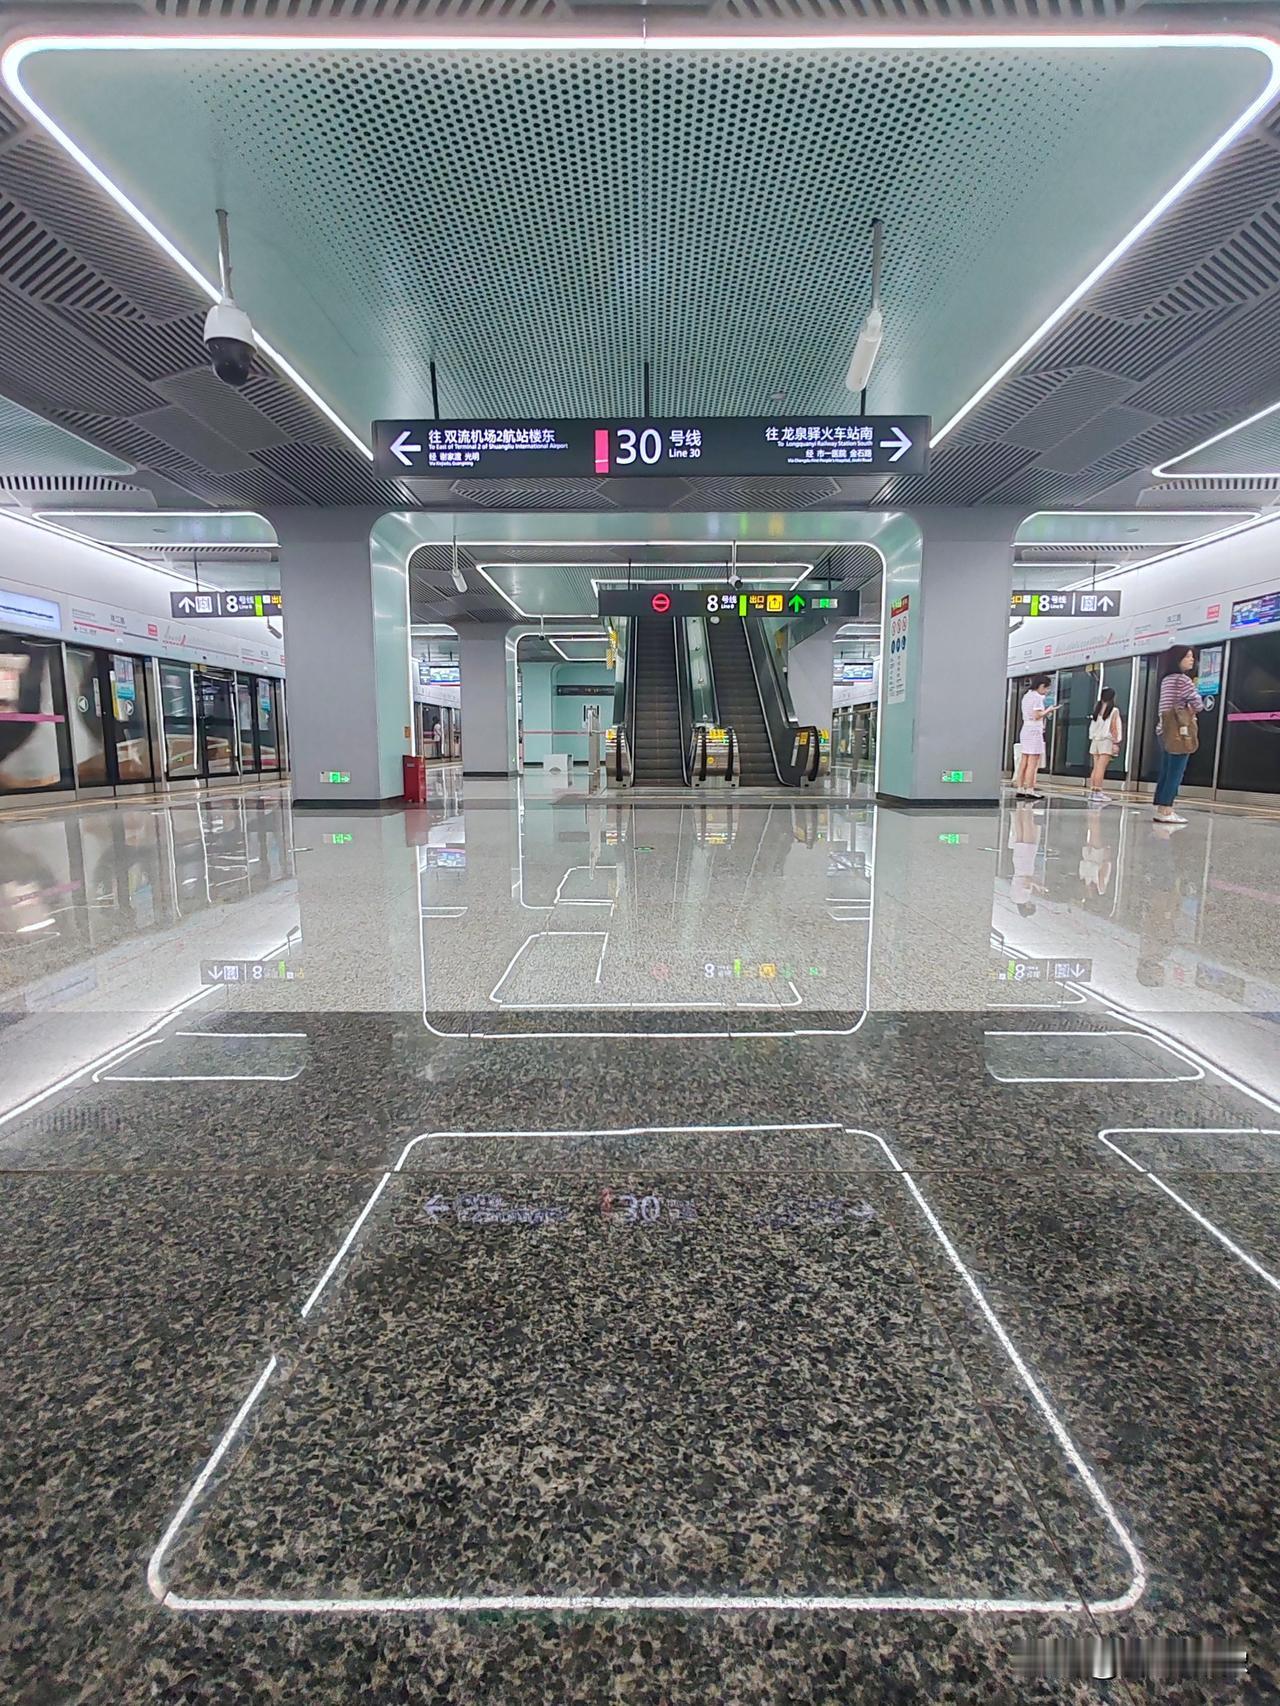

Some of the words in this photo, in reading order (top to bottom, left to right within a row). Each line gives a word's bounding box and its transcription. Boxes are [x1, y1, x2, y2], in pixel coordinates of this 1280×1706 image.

[428, 428, 442, 444] 往
[444, 428, 556, 444] 双流机场2航站楼东
[765, 426, 779, 441] 往
[780, 426, 873, 441] 龙泉驿火车站南
[488, 443, 515, 451] Shuangliu
[549, 442, 569, 450] Airport
[615, 428, 662, 465] 30
[669, 429, 702, 447] 号线
[668, 448, 688, 458] Line
[689, 448, 701, 458] 30
[805, 448, 814, 458] 经
[816, 449, 847, 458] 市一医院
[428, 451, 437, 461] 经
[464, 451, 480, 462] 光明
[226, 595, 239, 613] 8
[707, 594, 719, 612] 8
[721, 595, 737, 604] 号线
[749, 595, 765, 604] 出口
[1038, 595, 1050, 612] 8
